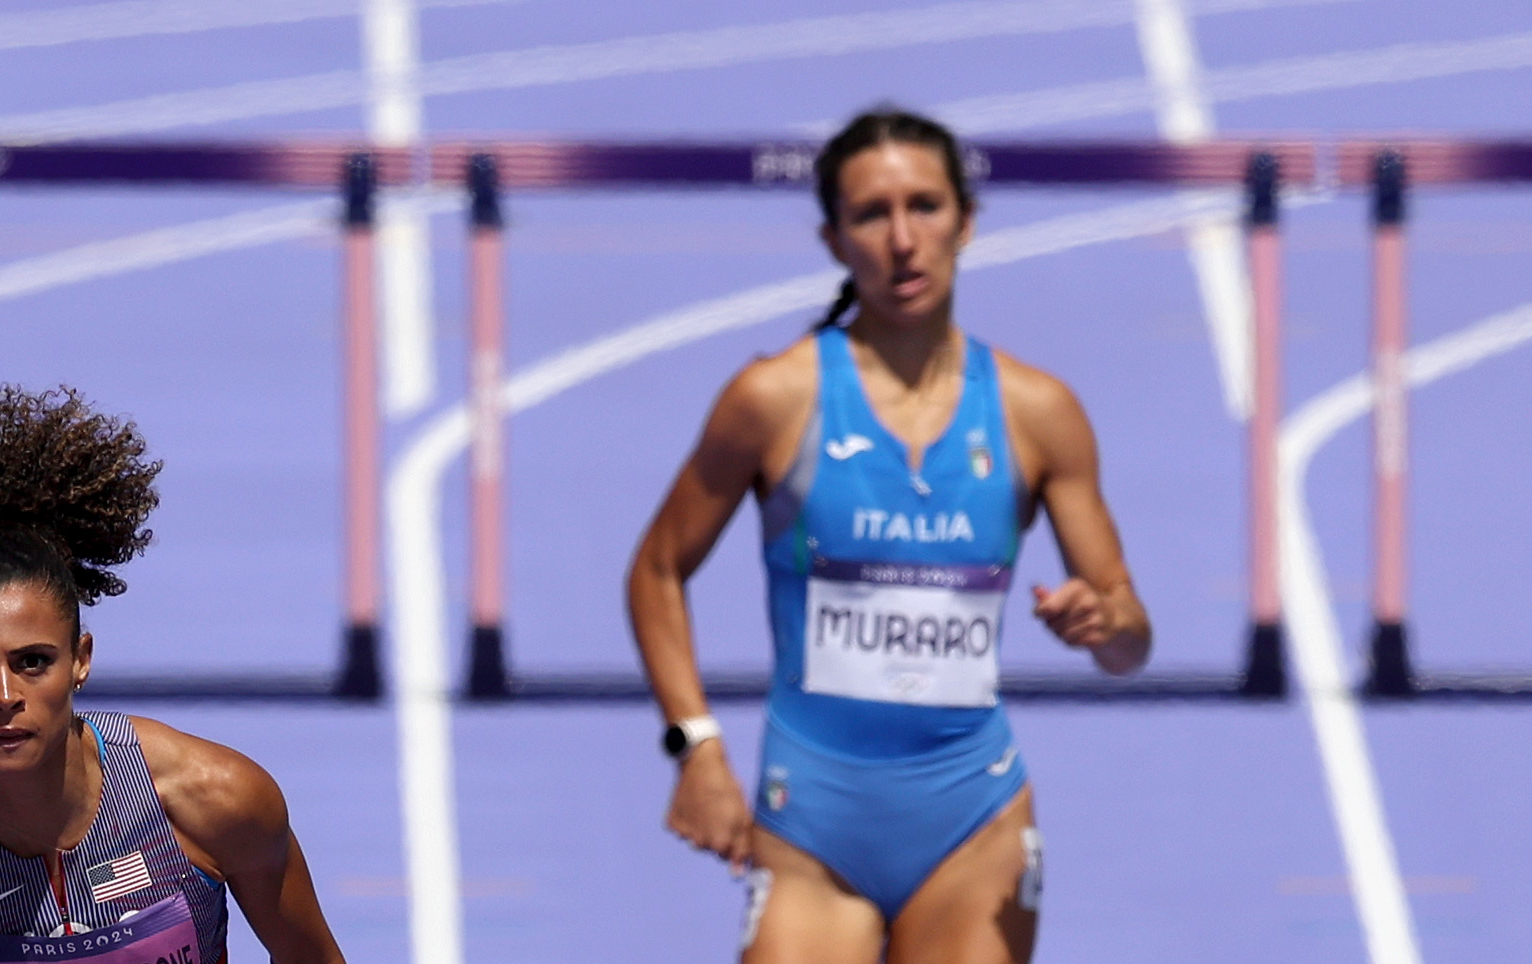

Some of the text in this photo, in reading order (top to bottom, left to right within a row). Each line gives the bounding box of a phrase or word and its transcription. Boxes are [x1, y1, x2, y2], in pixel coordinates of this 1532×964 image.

[852, 507, 974, 543] ITALIA
[816, 604, 991, 658] MURARO
[83, 927, 134, 951] 2024
